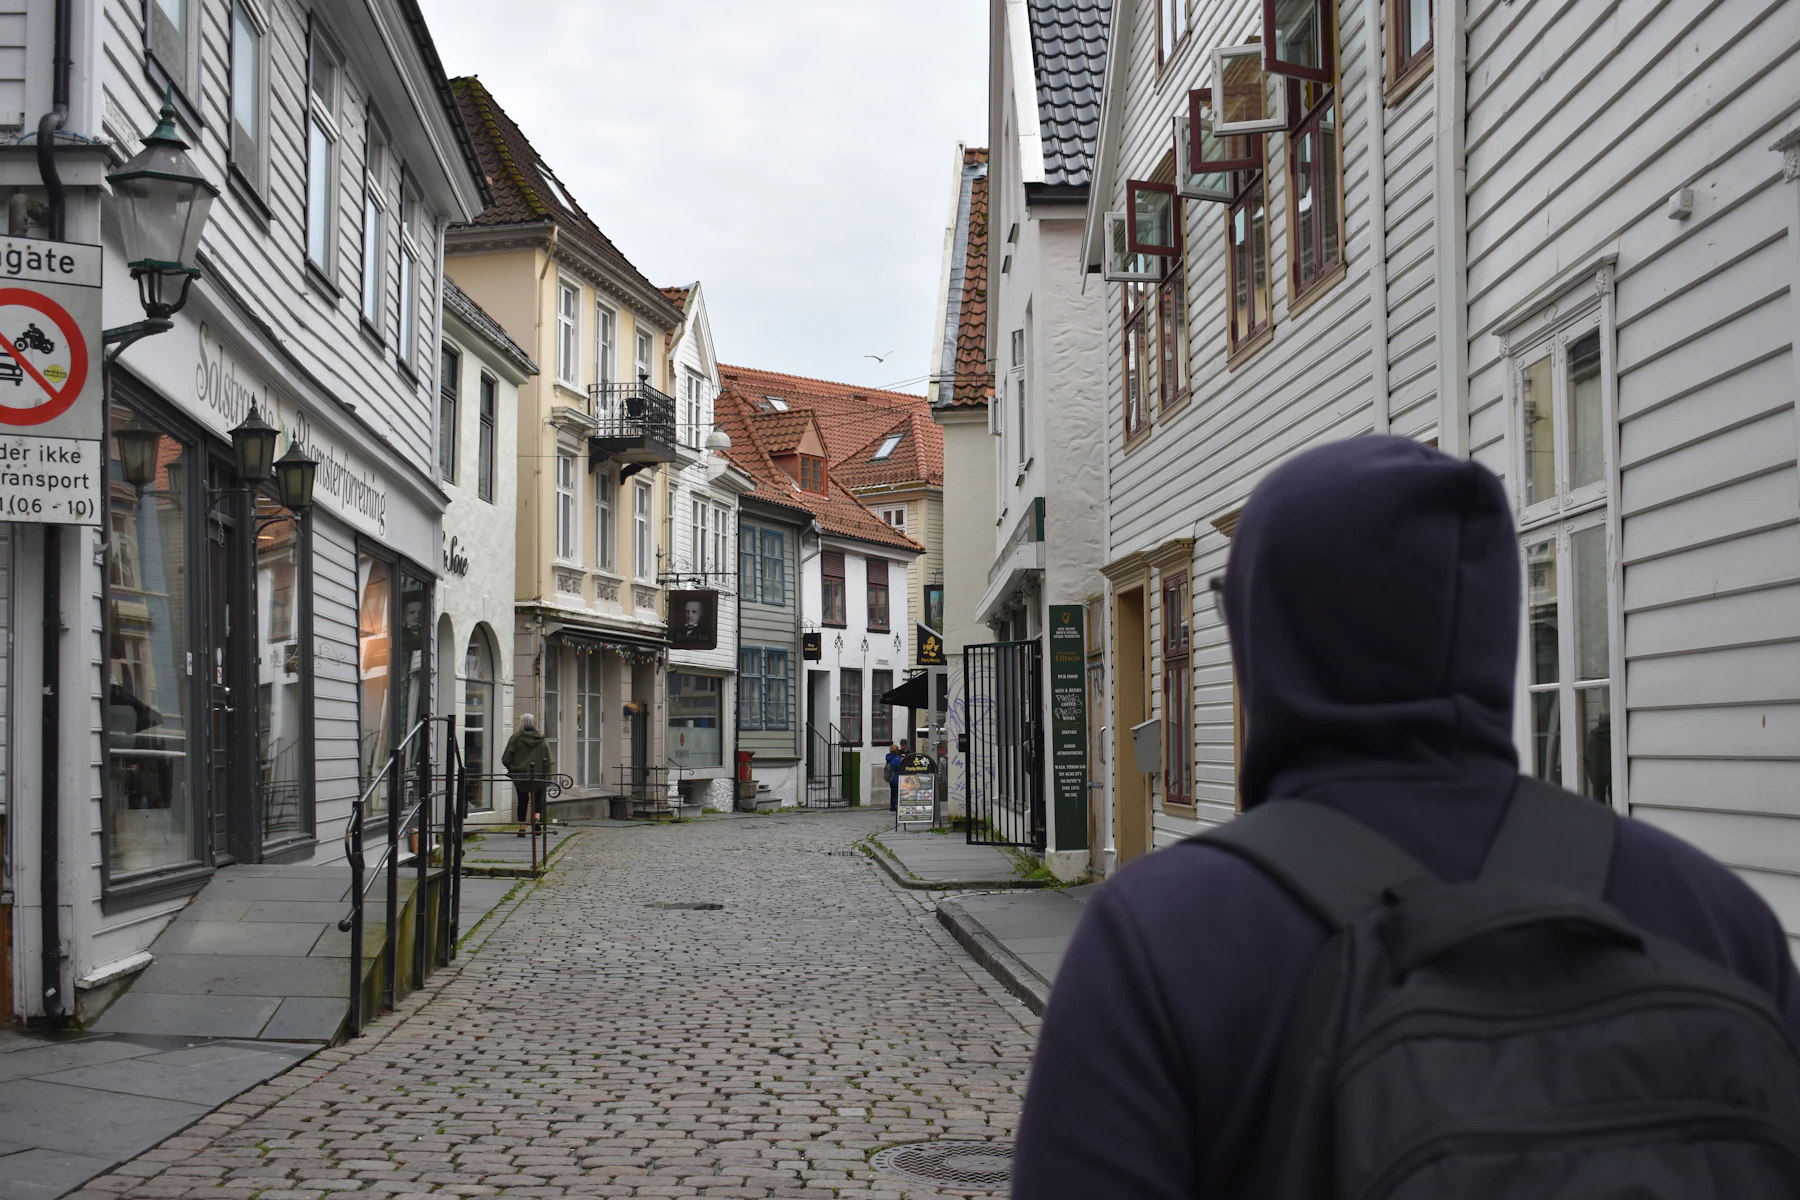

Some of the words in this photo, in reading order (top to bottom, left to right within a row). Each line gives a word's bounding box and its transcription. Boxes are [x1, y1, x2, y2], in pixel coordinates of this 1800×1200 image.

[0, 248, 75, 275] gate
[196, 319, 275, 428] Solstrad
[0, 443, 31, 461] der
[40, 444, 82, 464] ikke
[1, 473, 90, 492] ransport
[68, 498, 94, 519] 10)
